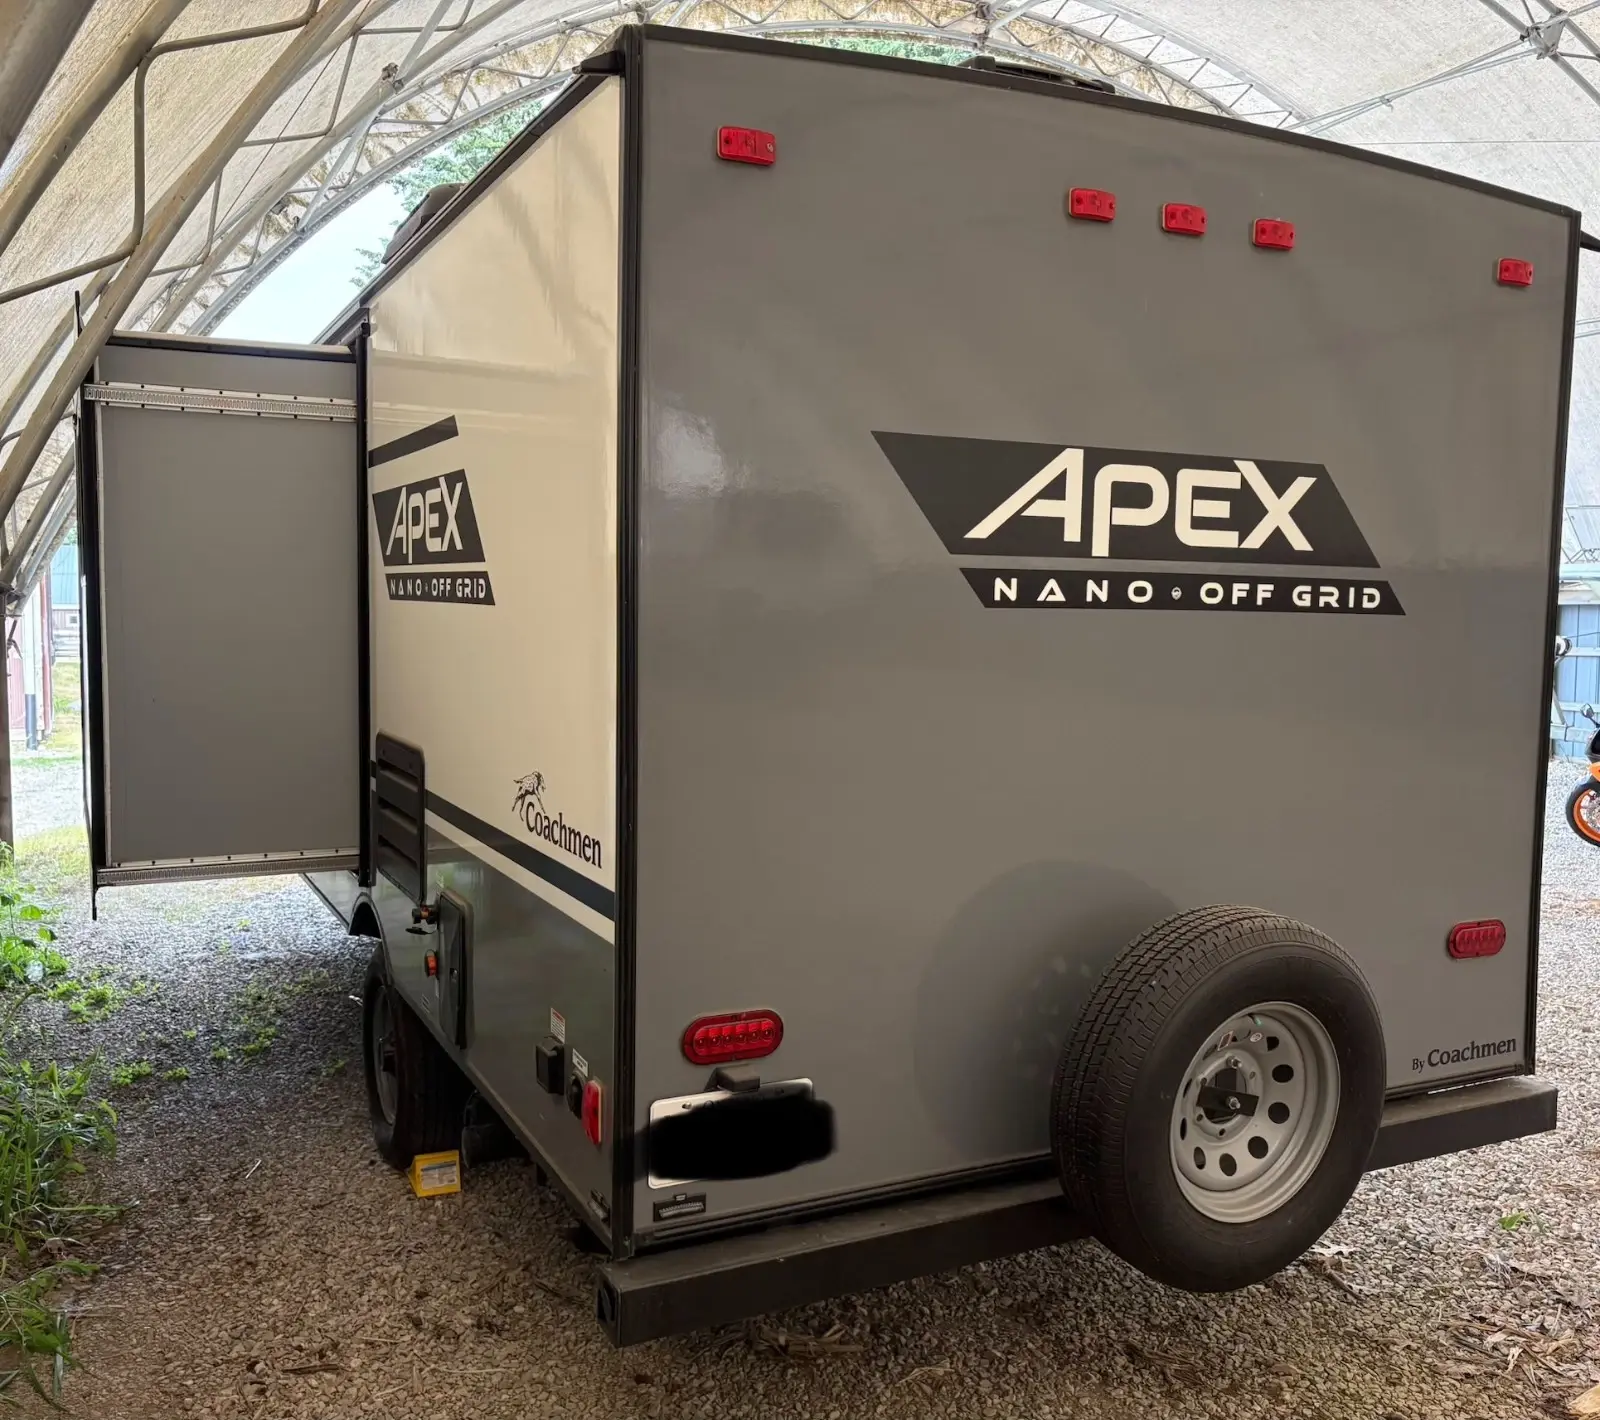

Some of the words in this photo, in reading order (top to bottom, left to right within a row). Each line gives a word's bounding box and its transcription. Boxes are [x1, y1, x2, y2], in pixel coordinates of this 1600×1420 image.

[386, 476, 464, 565] APEX
[963, 448, 1318, 557] APEX
[390, 578, 422, 597] NANO
[431, 578, 452, 597] OFF
[455, 578, 486, 599] GRID
[993, 576, 1153, 604] NANO
[1199, 581, 1275, 606] OFF
[1291, 584, 1381, 610] GRID
[525, 801, 602, 869] Coachmen
[1411, 1058, 1426, 1074] By
[1427, 1038, 1517, 1068] Coachmen
